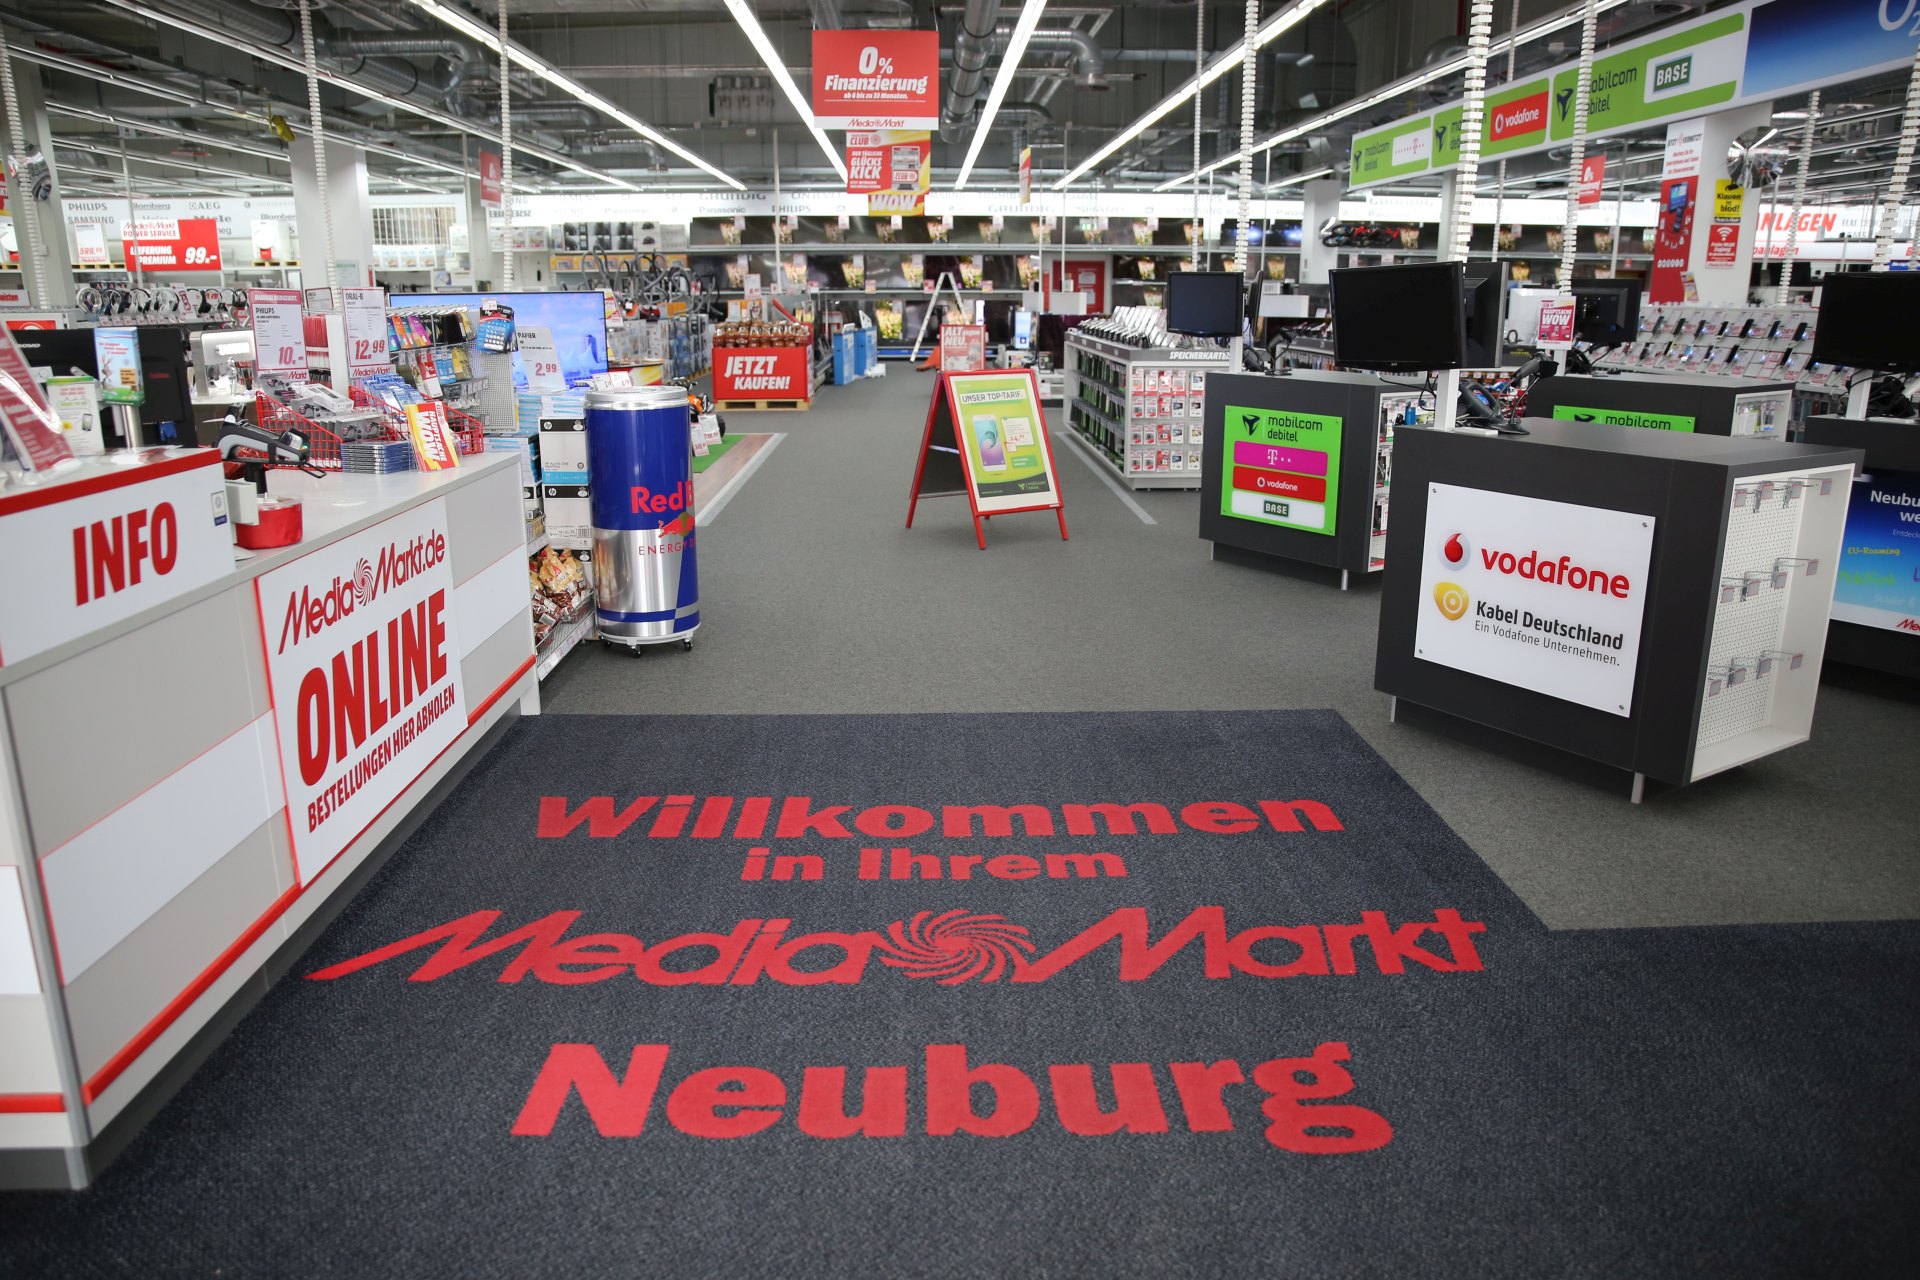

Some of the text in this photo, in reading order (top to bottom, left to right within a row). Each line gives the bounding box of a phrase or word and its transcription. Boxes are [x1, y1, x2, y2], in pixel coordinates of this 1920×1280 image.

[1656, 61, 1688, 86] BASE
[824, 75, 928, 94] Finanzierung
[848, 118, 905, 127] Media Markt
[1505, 109, 1540, 127] vodafone
[850, 137, 869, 145] CLUB
[850, 157, 882, 166] GLÜCKS
[849, 167, 882, 180] KICK
[699, 193, 767, 201] GRUNDIG
[870, 194, 918, 211] WOW
[68, 203, 108, 212] PHILIPS
[700, 205, 811, 213] Panasonic PHILIPS
[988, 204, 1055, 213] GRUNDIG
[68, 216, 114, 224] SAMSUNG
[129, 246, 173, 256] LEFERUNG
[138, 256, 177, 265] PREMIUM
[345, 292, 364, 300] ORAL-B
[1542, 314, 1570, 325] WOW
[944, 327, 964, 337] ALT
[944, 336, 968, 346] NEU.
[279, 346, 304, 365] 10.-
[355, 339, 385, 360] 12.99
[352, 367, 391, 377] Media Markt
[535, 362, 557, 377] 2.99
[724, 356, 778, 378] JETZT
[288, 371, 308, 380] Markt
[734, 376, 791, 390] KAUFEN!
[962, 390, 1024, 403] UNSER TOP-TARIF.
[1268, 416, 1323, 432] mobilcom
[1605, 415, 1671, 431] mobilcom
[416, 412, 441, 461] WOW
[1268, 429, 1298, 442] debitel
[1266, 480, 1298, 491] vodafone
[631, 481, 684, 514] Red
[1265, 503, 1288, 515] BASE
[73, 501, 178, 607] INFO
[639, 540, 688, 558] ENERGY
[1847, 547, 1900, 557] EU-Roaming
[1481, 547, 1631, 599] vodafone
[277, 528, 446, 656] Media Markt.de
[1476, 600, 1624, 651] Kabel Deutschland
[1474, 620, 1620, 667] Ein Vodafone Unternehmen.
[296, 587, 448, 787] ONLINE
[307, 682, 456, 834] BESTELLUNGEN HIER ABHOLEN
[536, 795, 1345, 838] Willkommen
[739, 848, 1129, 881] in Ihrem
[303, 905, 1488, 986] Media Markt
[510, 1041, 1394, 1155] Neuburg
